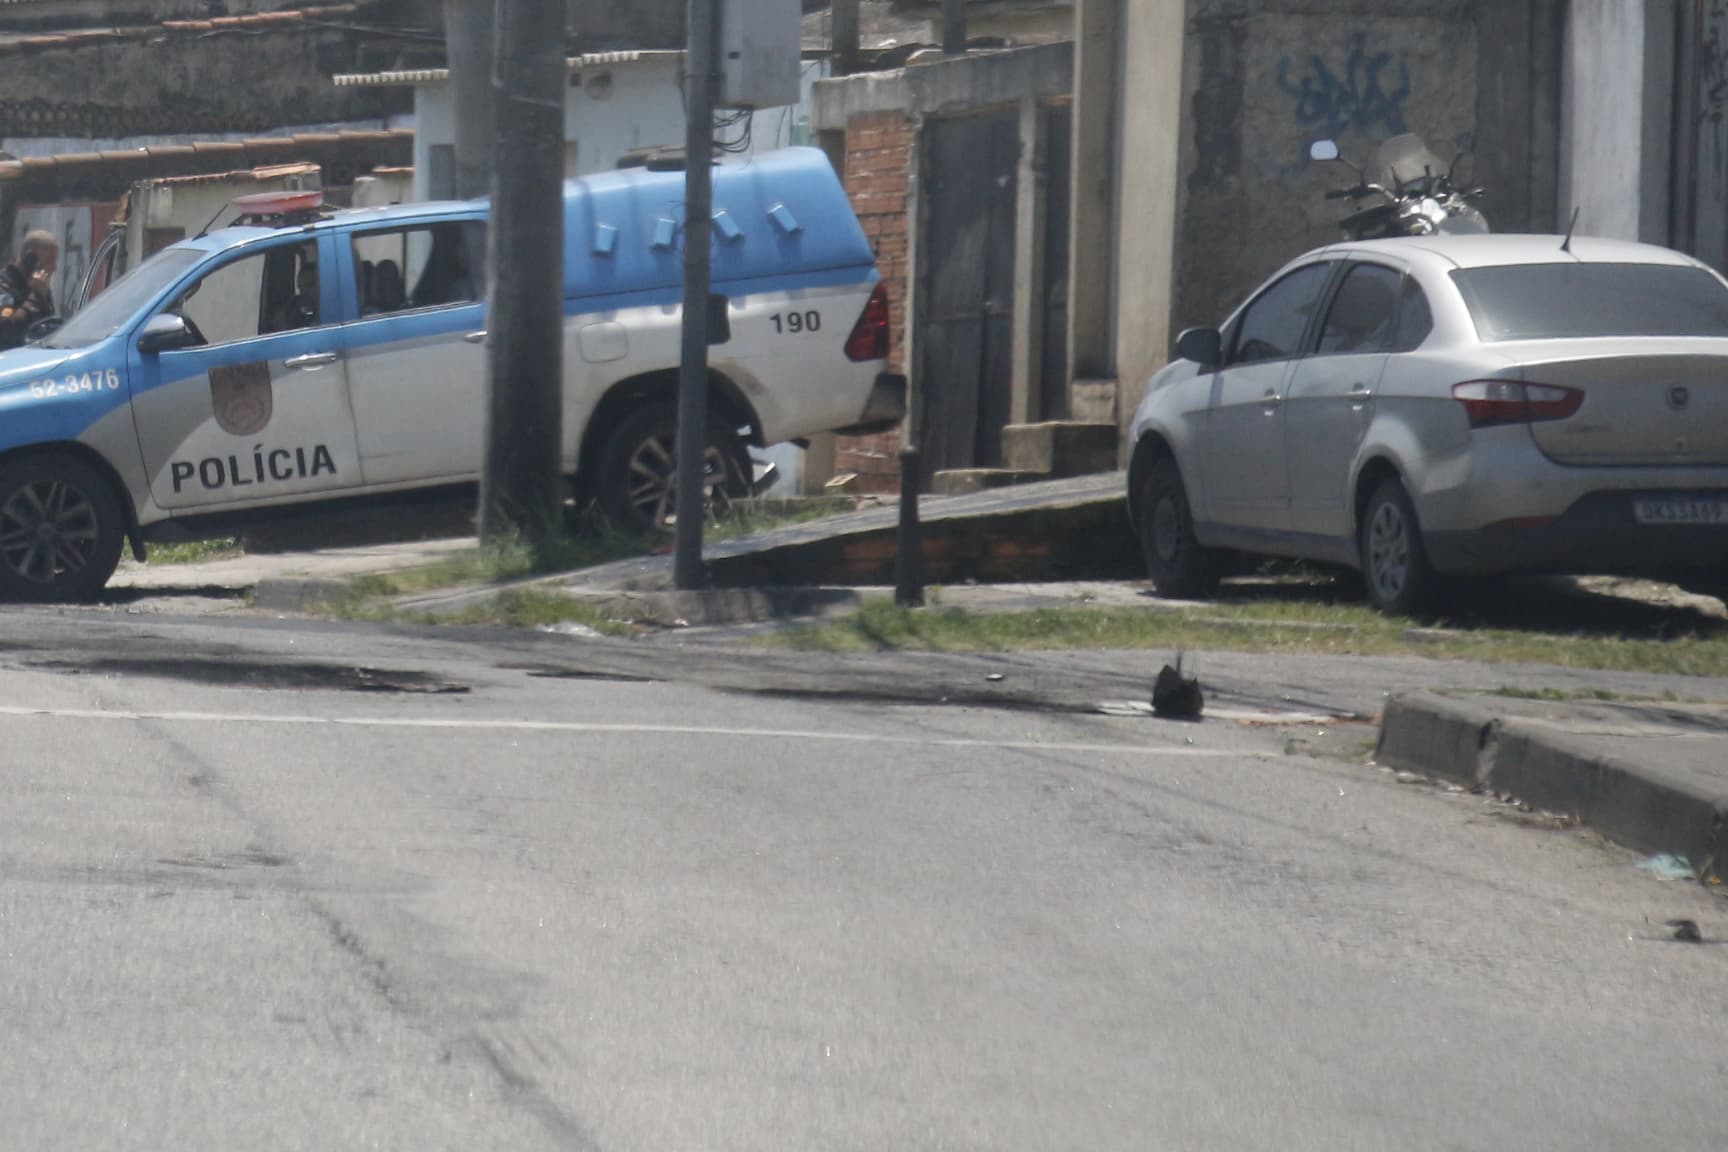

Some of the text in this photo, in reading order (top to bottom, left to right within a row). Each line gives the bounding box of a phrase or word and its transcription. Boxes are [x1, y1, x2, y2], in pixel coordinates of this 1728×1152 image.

[769, 310, 822, 335] 190
[29, 368, 120, 399] 52-3476
[170, 442, 337, 494] POLÍCIA
